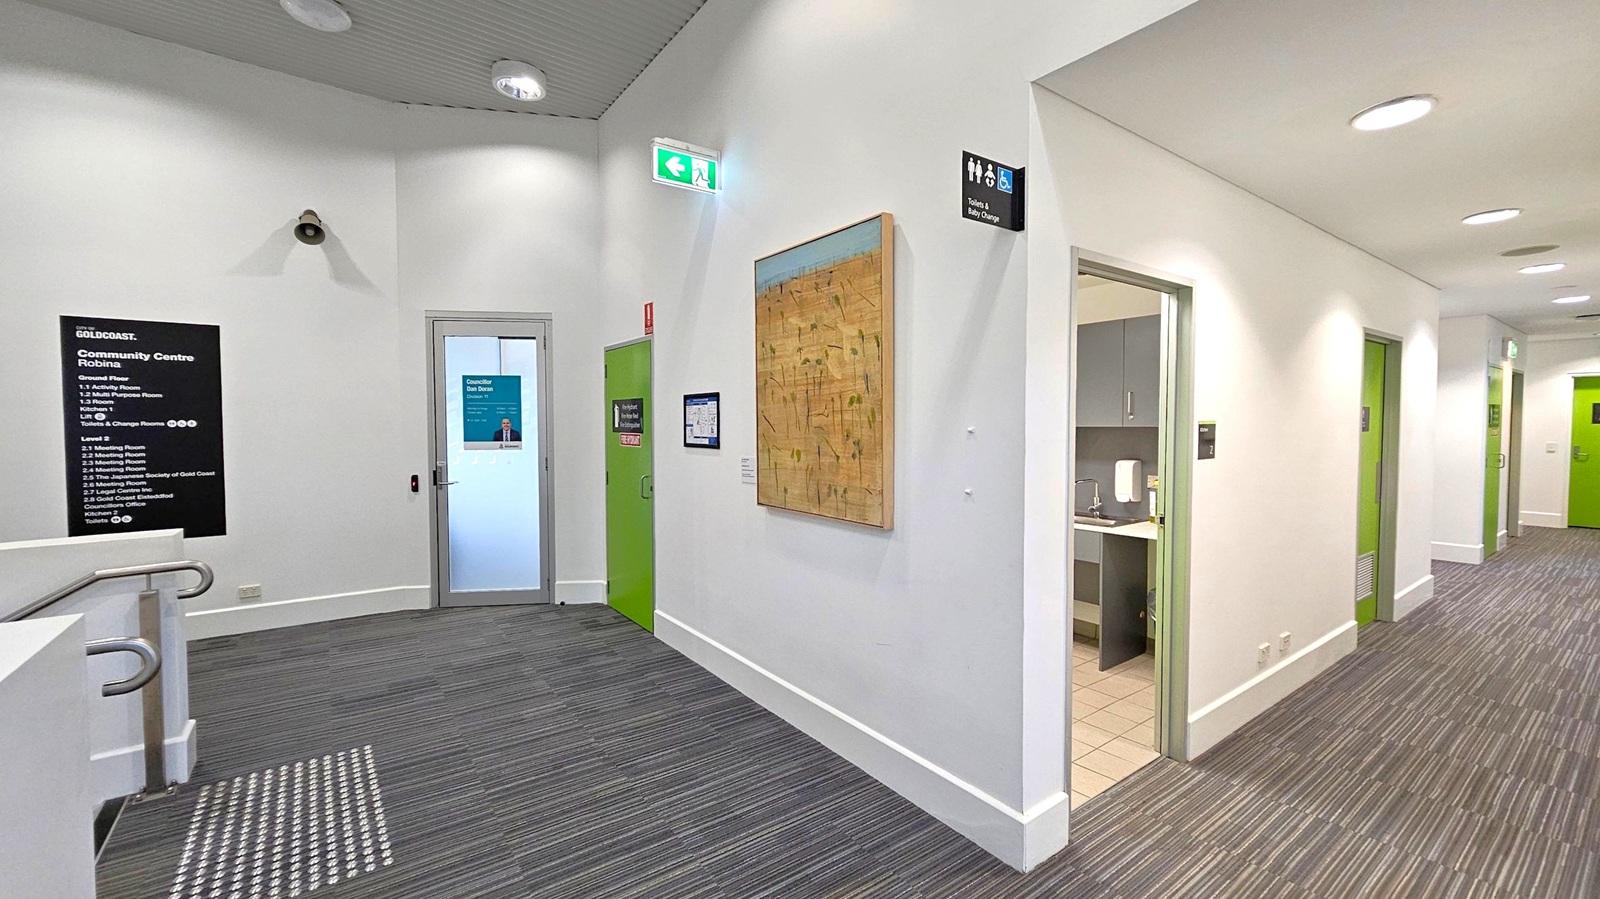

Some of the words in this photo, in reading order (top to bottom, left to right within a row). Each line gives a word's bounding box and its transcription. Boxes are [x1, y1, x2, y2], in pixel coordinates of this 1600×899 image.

[968, 198, 984, 208] Toilets
[968, 207, 980, 218] Baby
[981, 211, 999, 223] Change
[77, 350, 150, 361] Community
[153, 353, 194, 361] Centre
[78, 359, 121, 368] Robina
[1210, 445, 1213, 454] 2
